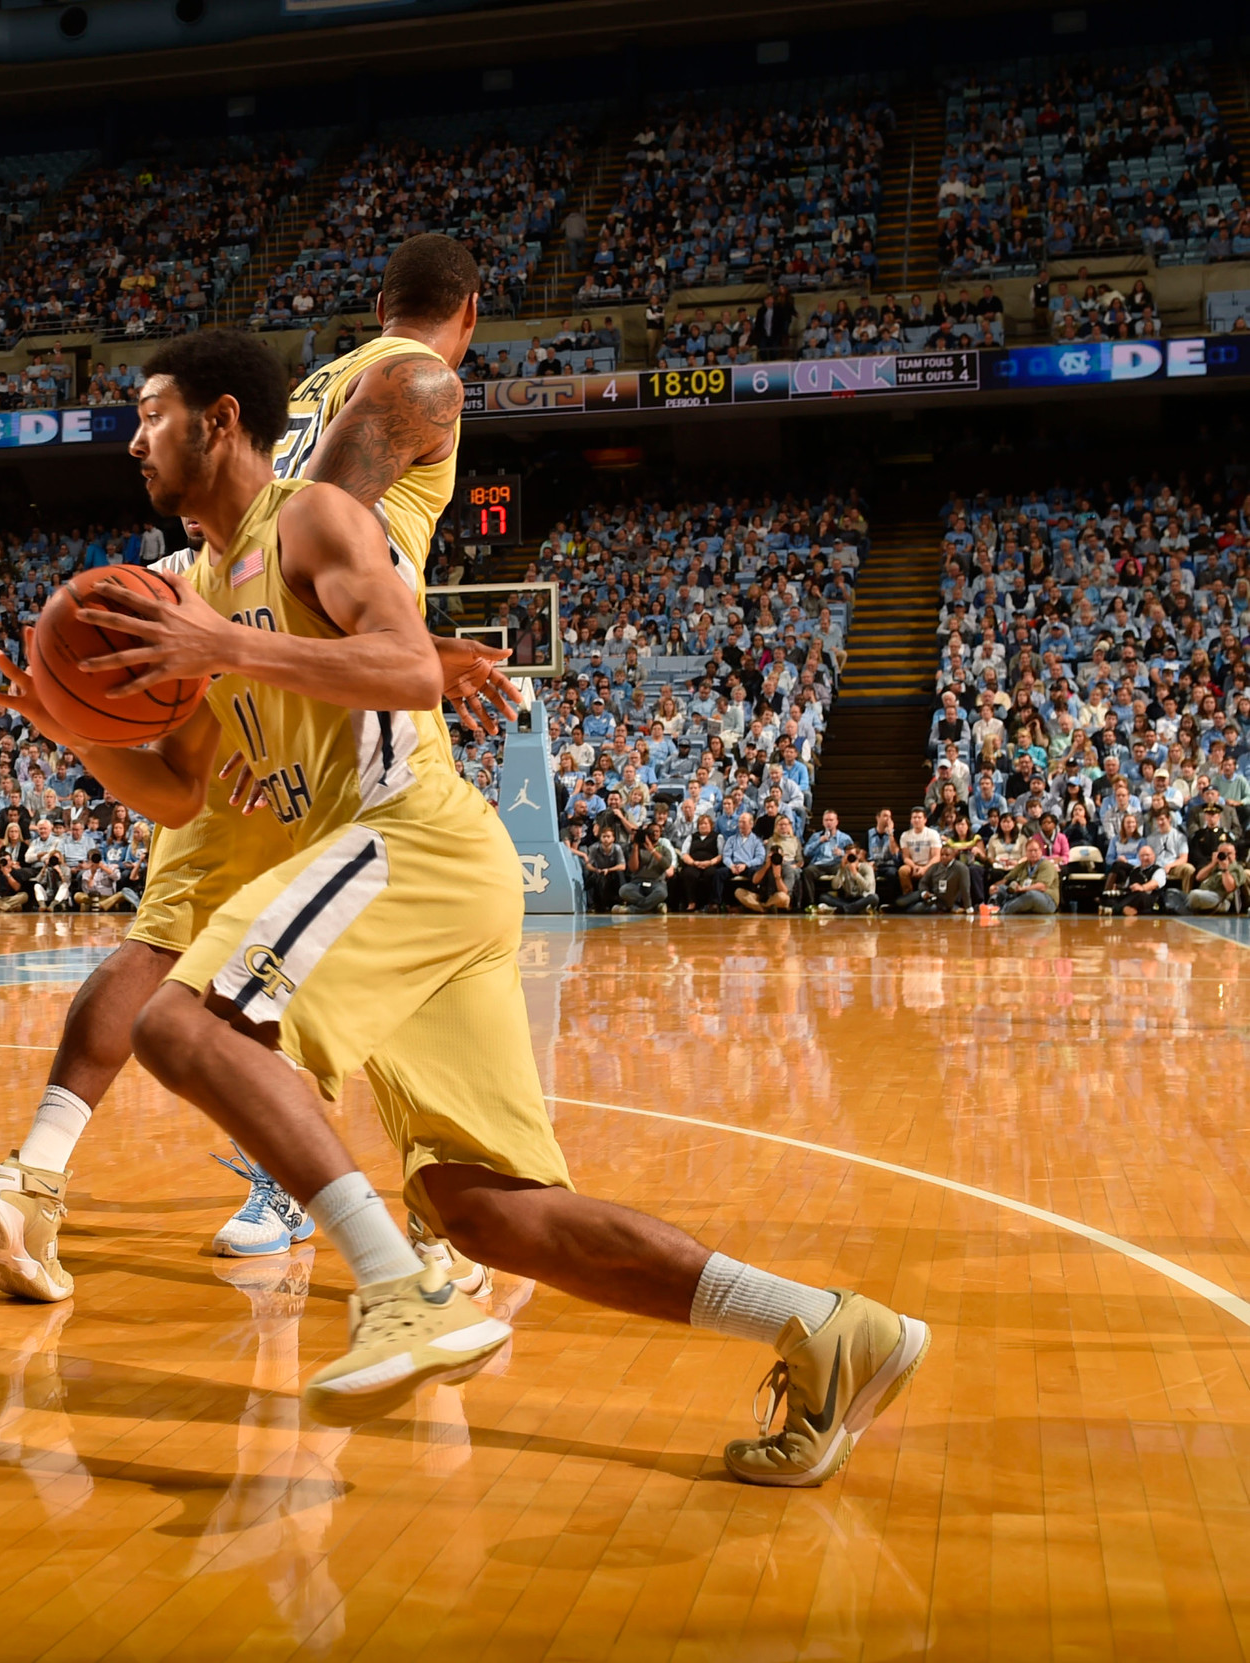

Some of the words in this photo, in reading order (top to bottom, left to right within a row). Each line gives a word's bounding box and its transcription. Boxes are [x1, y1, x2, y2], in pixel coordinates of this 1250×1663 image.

[897, 359, 922, 370] TEAM
[924, 357, 953, 368] FOULS
[960, 354, 968, 367] 1
[1111, 339, 1207, 379] DE
[649, 369, 725, 397] 18:09
[752, 370, 769, 393] 6
[898, 372, 923, 383] TIME
[926, 371, 953, 382] OUTS
[959, 370, 969, 382] 4
[602, 379, 618, 402] 4
[665, 398, 701, 408] PERIOD
[19, 410, 92, 445] DE
[471, 486, 510, 505] 18:09
[481, 506, 506, 535] 17
[233, 687, 269, 764] 11
